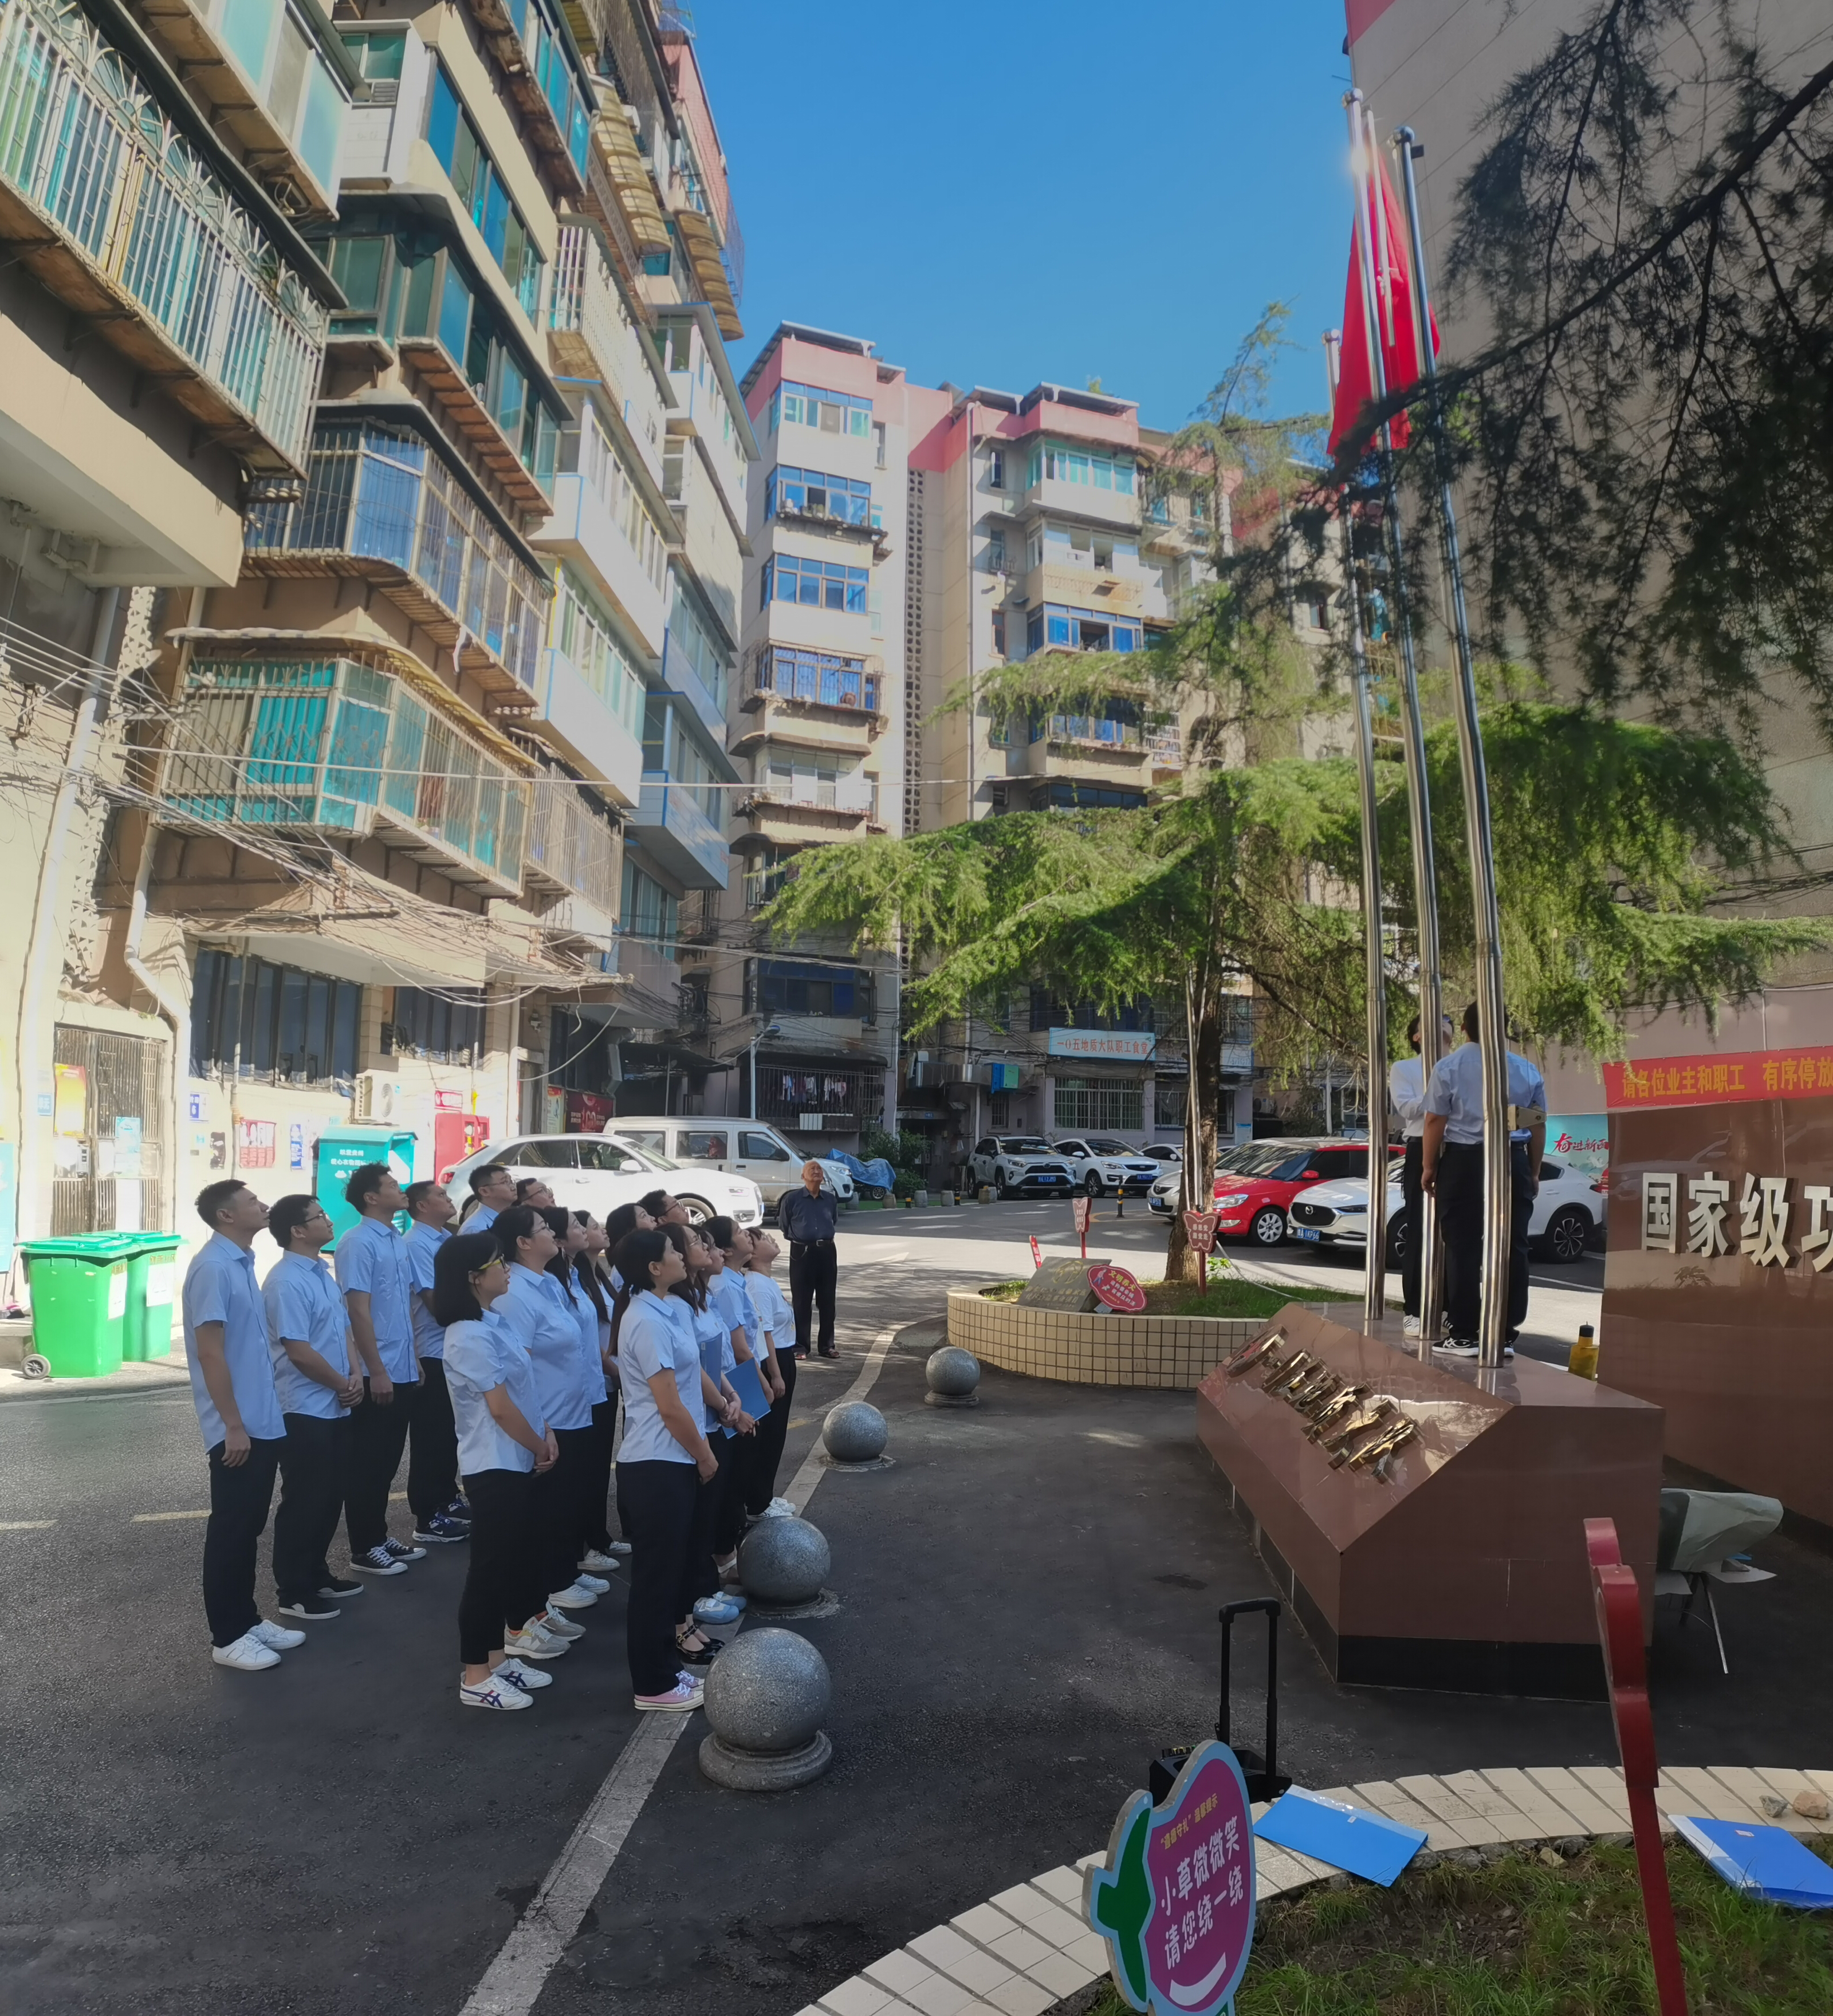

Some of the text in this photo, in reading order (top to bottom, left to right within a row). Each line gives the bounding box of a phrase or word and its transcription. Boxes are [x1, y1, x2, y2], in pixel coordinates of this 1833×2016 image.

[1622, 1056, 1833, 1098] 请各位业主和职工 有序停放
[1108, 1270, 1136, 1292] 文明养犬
[1161, 1816, 1240, 1916] 小草微微笑
[1165, 1865, 1244, 1970] 请您绕一绕
